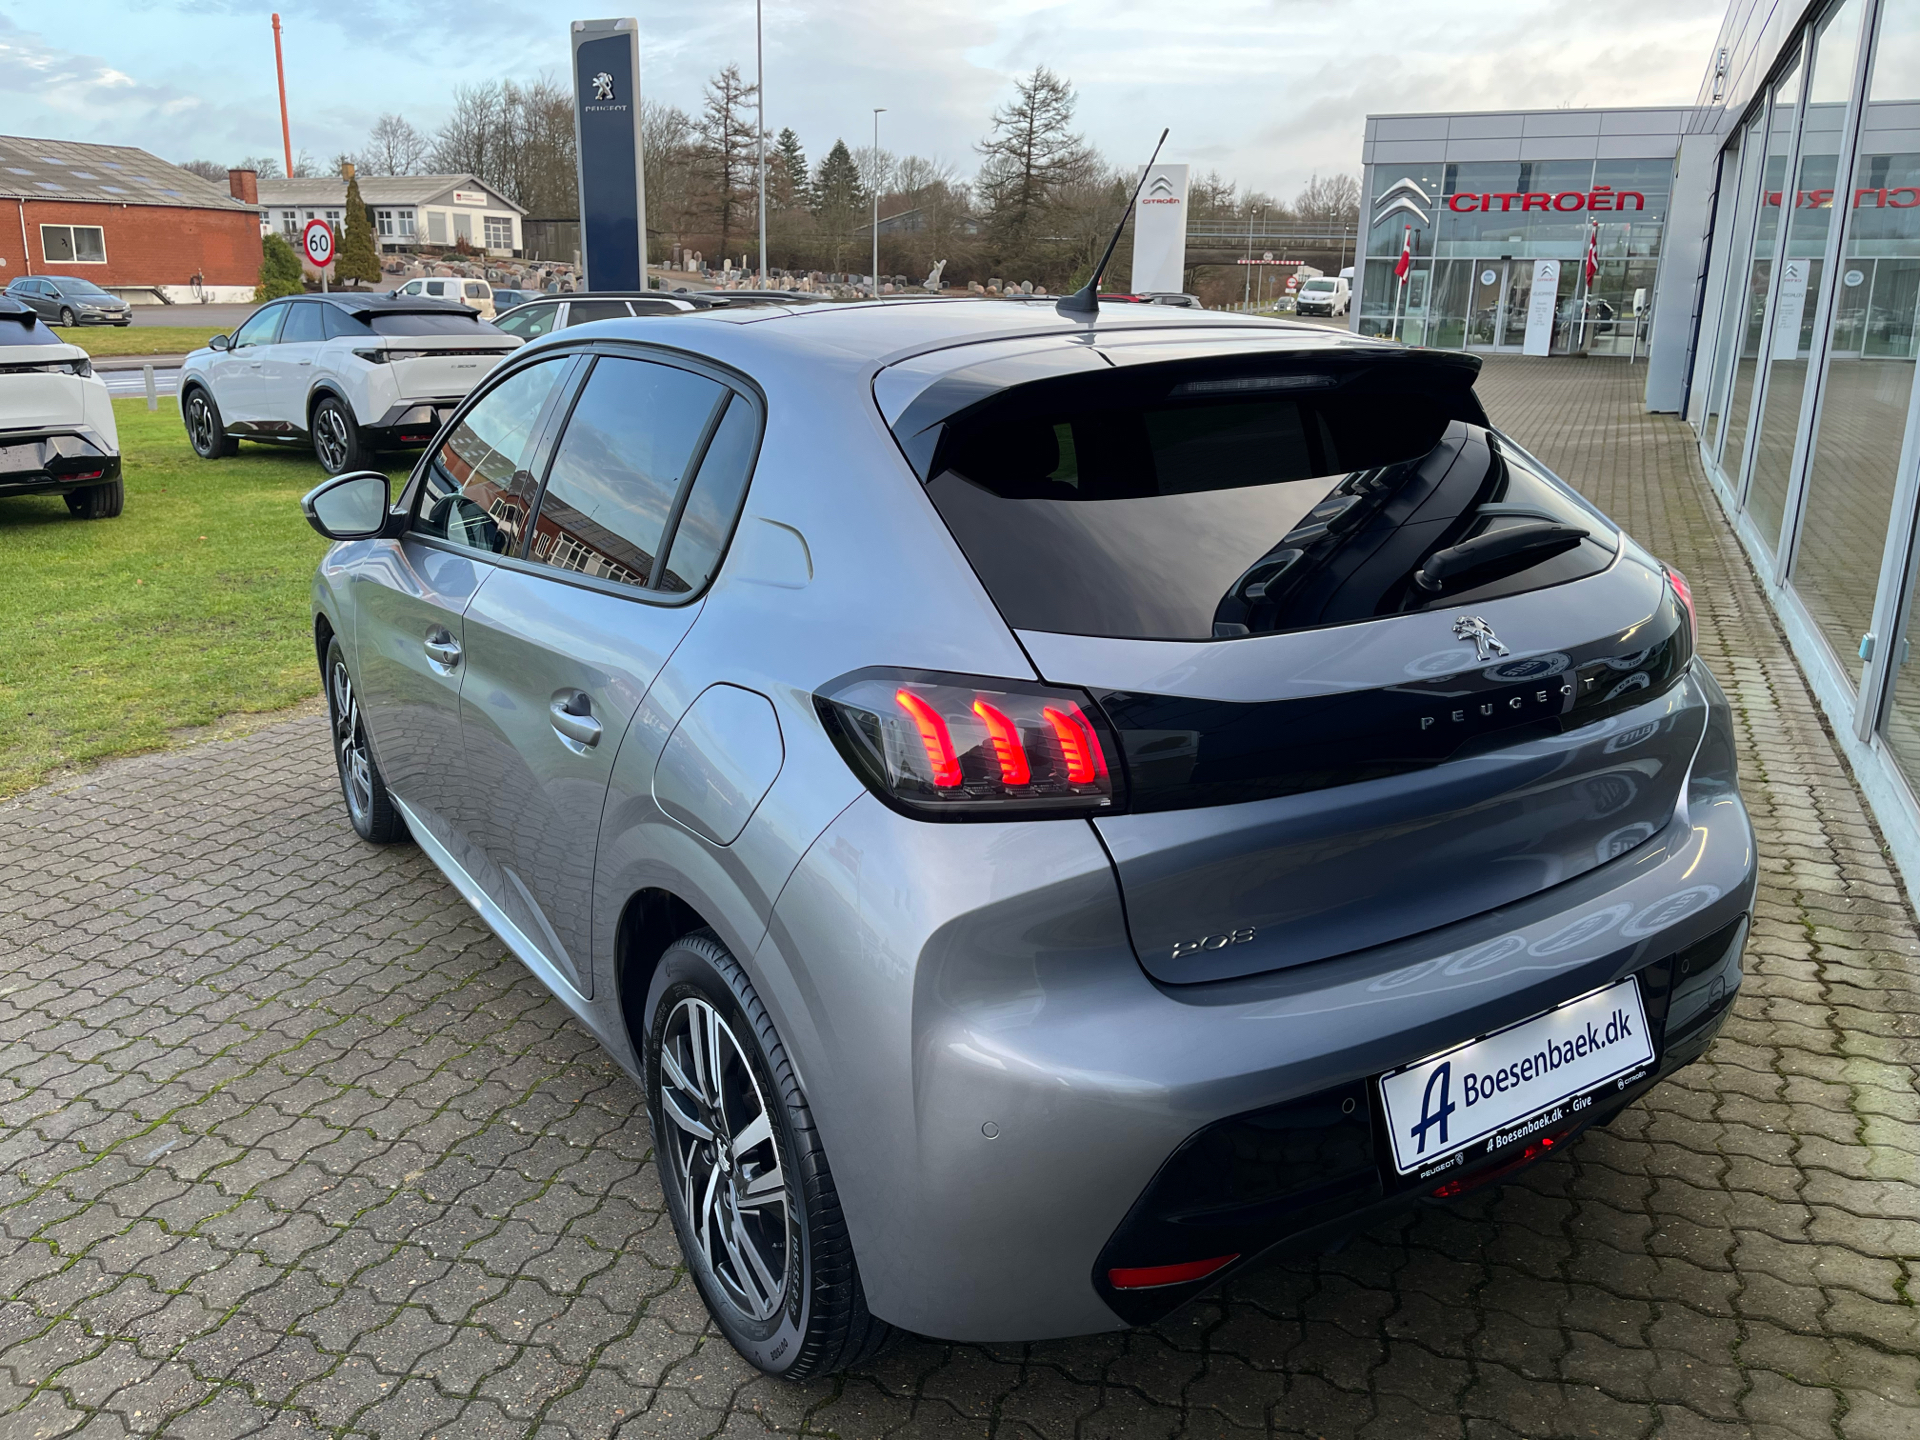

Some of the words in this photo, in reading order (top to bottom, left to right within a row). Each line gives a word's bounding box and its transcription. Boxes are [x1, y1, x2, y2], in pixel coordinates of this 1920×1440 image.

[1449, 186, 1645, 212] CITROËN
[310, 233, 329, 252] 60
[1421, 677, 1595, 730] PEUGEOT
[1172, 926, 1256, 960] 208
[1410, 1060, 1456, 1155] A
[1463, 1008, 1633, 1108] Boesenbaek.dk
[1624, 1070, 1647, 1086] CITROËN
[1496, 1108, 1563, 1149] Boesenbaek.dk
[1572, 1096, 1592, 1112] Give
[1420, 1158, 1455, 1179] PEUGEOT
[791, 1234, 800, 1287] 195/55
[769, 1337, 789, 1362] OUTSIDE
